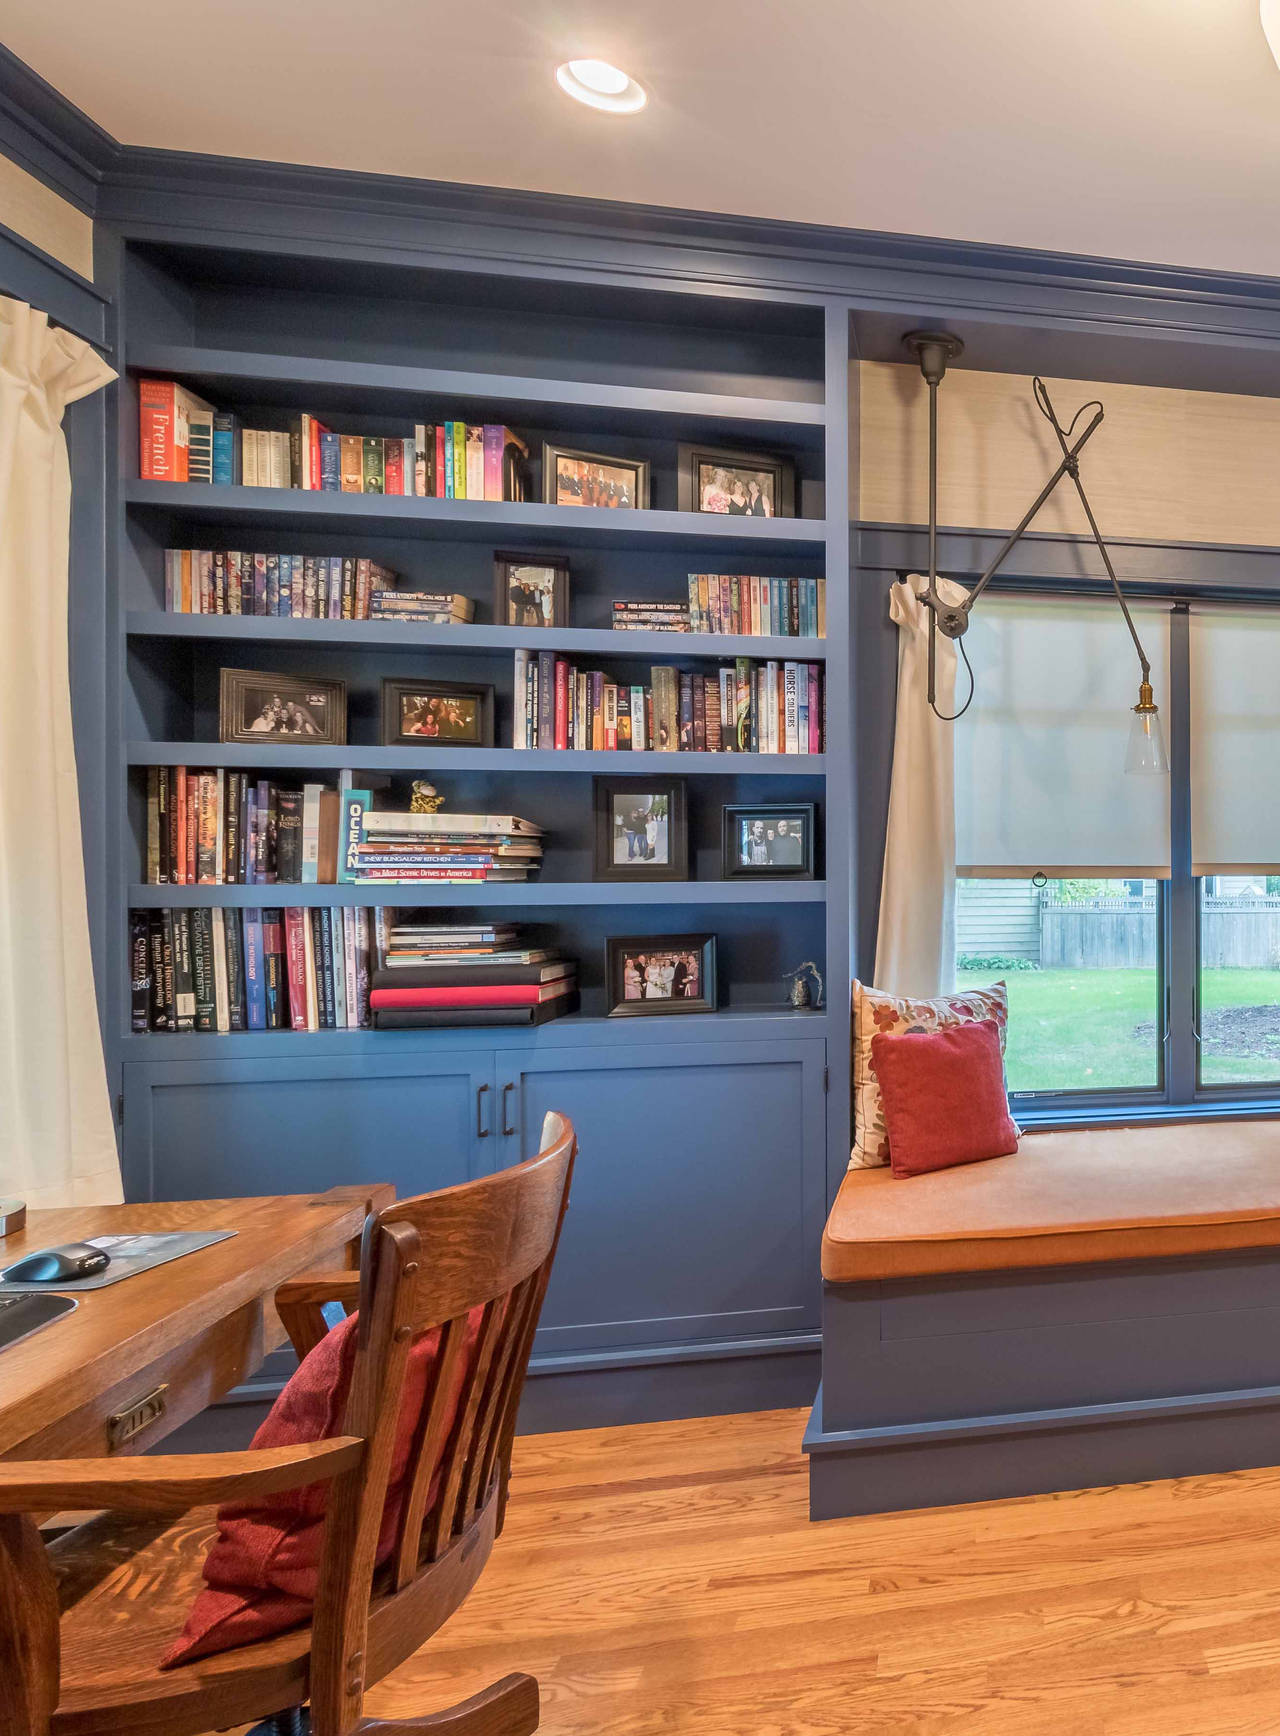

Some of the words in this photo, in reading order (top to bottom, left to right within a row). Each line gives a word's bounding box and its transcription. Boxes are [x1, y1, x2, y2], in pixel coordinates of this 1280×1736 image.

[143, 438, 152, 476] Dictionary
[152, 413, 170, 476] French
[786, 669, 796, 696] HORSE
[787, 697, 795, 728] SOLDIERS
[201, 781, 210, 815] Bungalow
[348, 804, 362, 868] OCEAN
[372, 870, 382, 878] The
[382, 869, 398, 877] Most
[399, 869, 420, 877] Scenic
[420, 869, 440, 877] Drives
[446, 869, 473, 878] America
[154, 934, 163, 962] Human
[193, 910, 204, 955] OPERATIVE
[137, 938, 147, 985] CONCEPTS
[163, 944, 172, 963] ORAL
[248, 945, 256, 980] PATHOLOGY
[156, 963, 165, 1008] Embryology
[165, 966, 173, 1005] HISTOLOGY
[195, 956, 205, 1001] DENTISTRY
